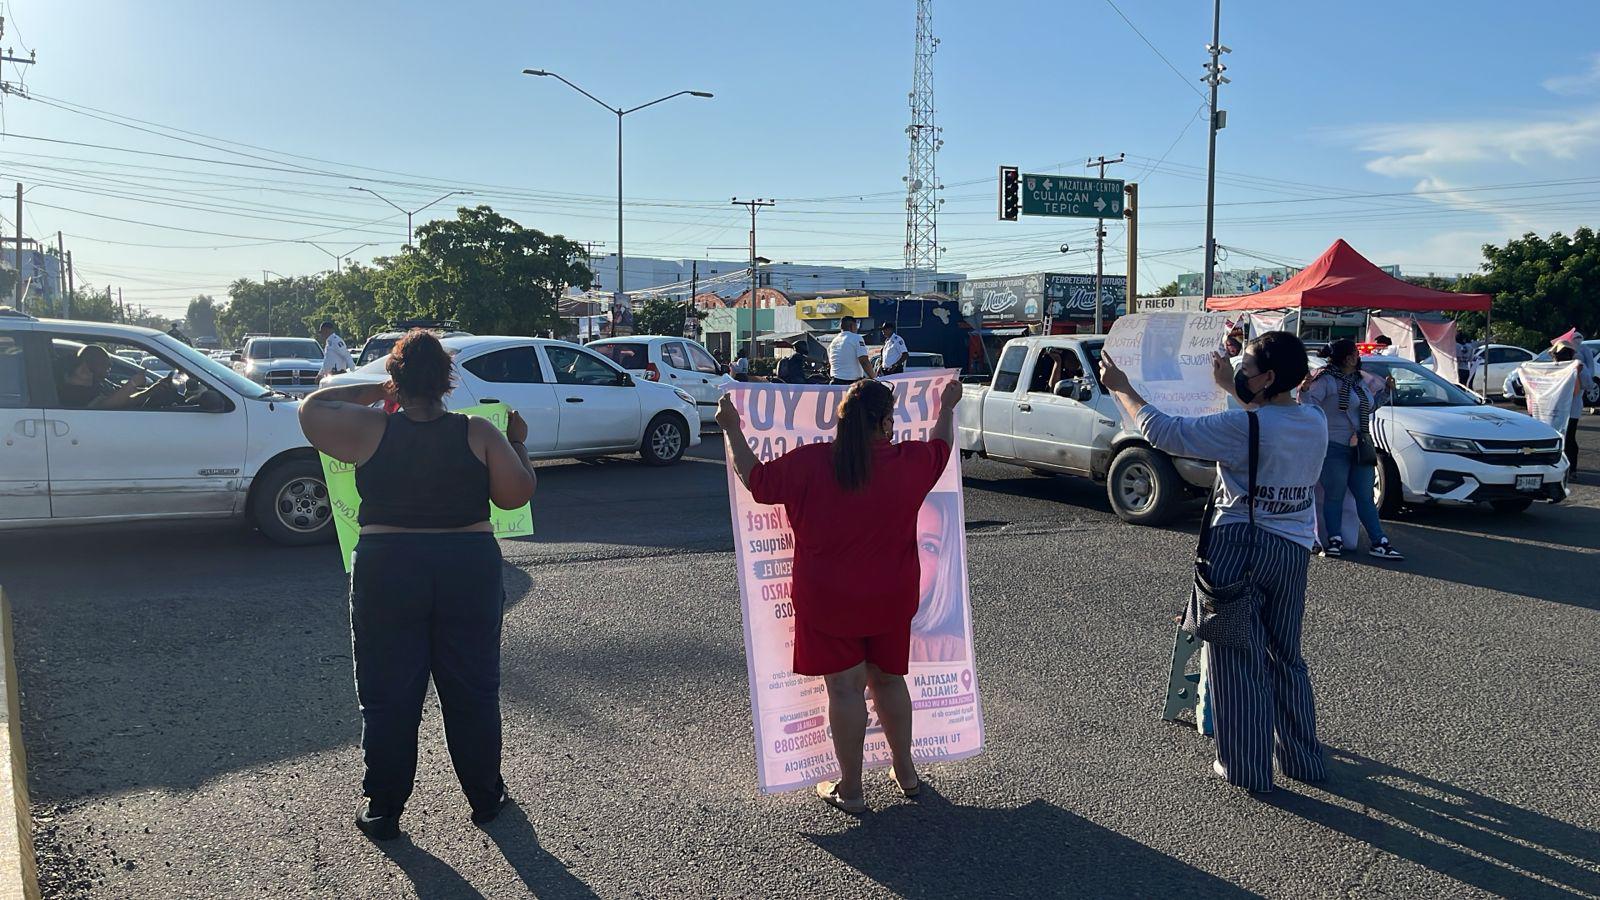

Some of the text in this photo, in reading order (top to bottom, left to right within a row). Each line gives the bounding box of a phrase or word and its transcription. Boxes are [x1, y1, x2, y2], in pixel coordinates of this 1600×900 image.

[1033, 191, 1089, 203] CULIACAN
[1044, 202, 1080, 214] TEPIC
[1137, 299, 1175, 309] Y RIEGO
[1278, 486, 1307, 500] FALTAS
